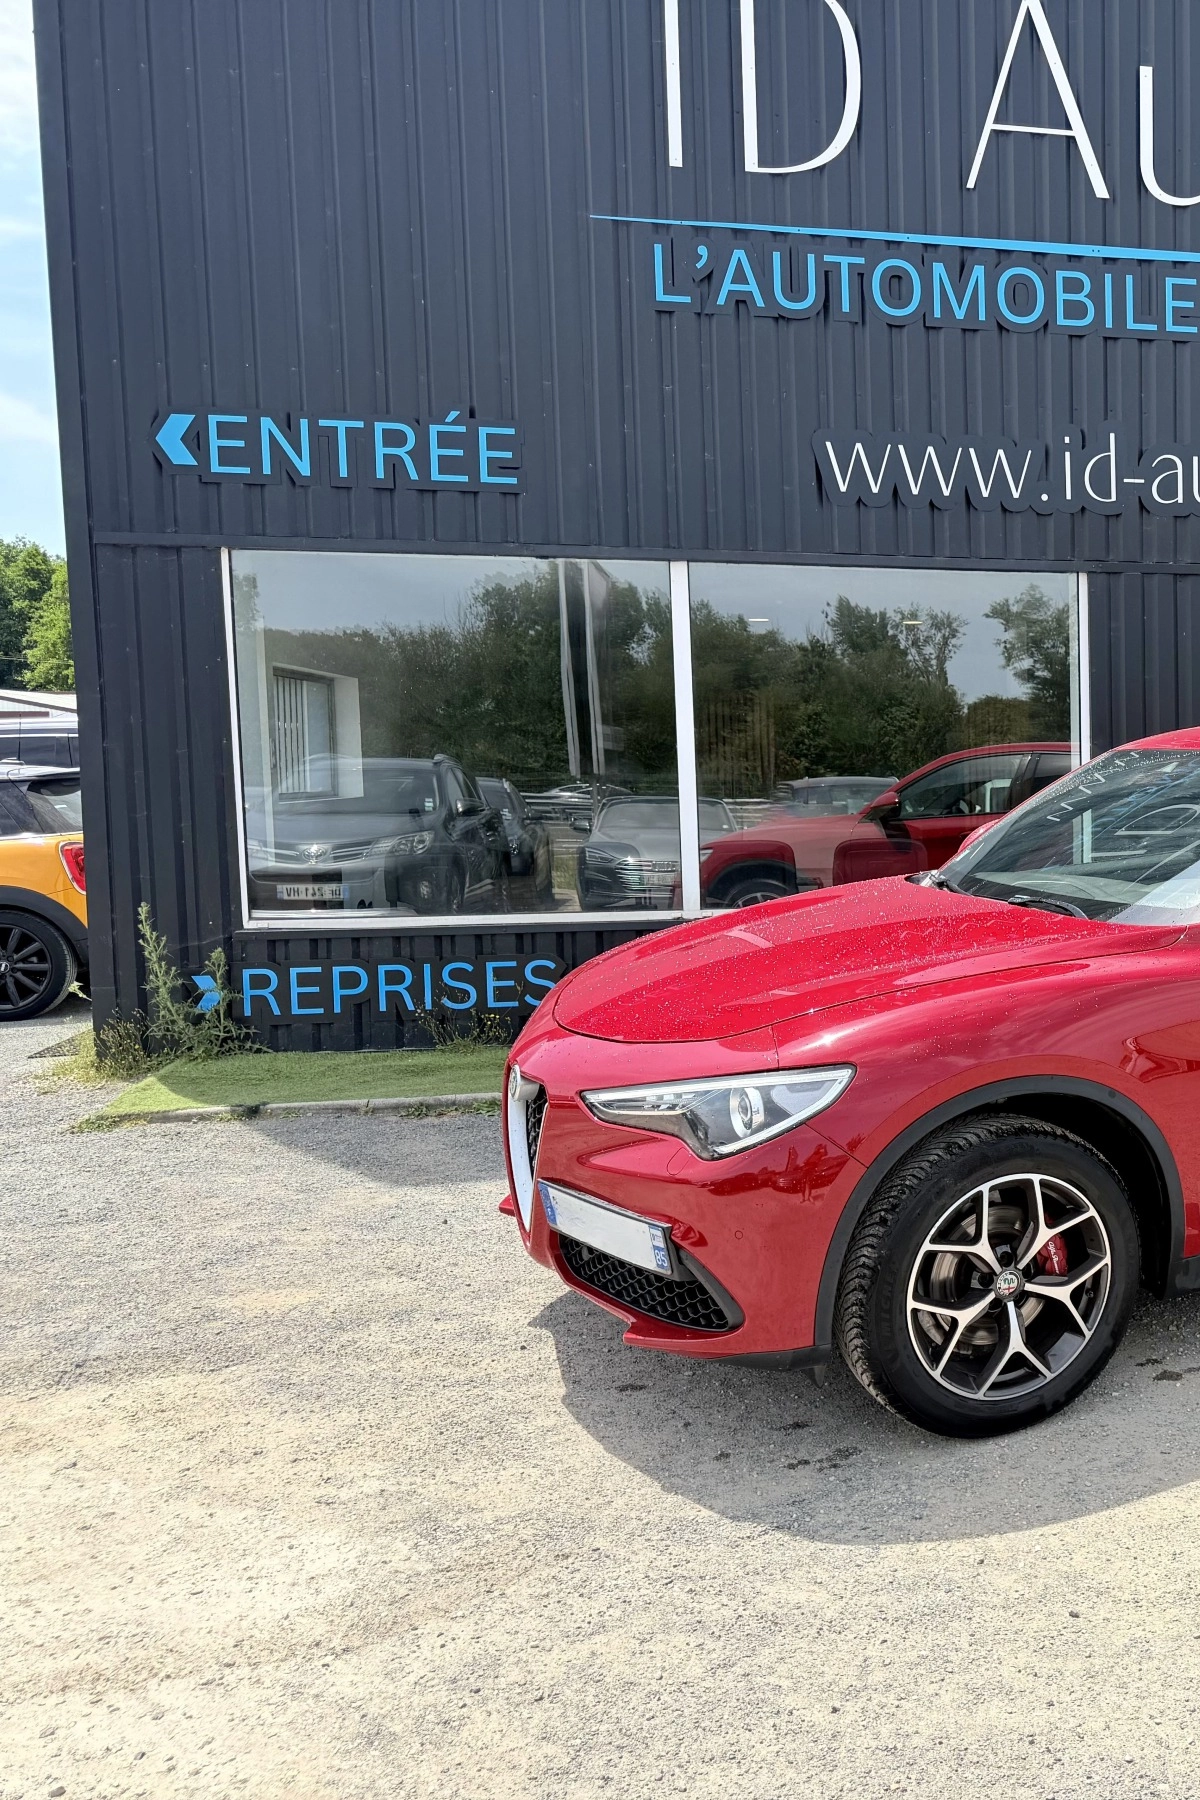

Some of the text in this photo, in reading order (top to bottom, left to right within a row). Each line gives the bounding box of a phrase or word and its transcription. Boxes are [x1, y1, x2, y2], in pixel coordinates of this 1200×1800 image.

[663, 0, 861, 175] ID
[653, 242, 1199, 334] L'AUTOMOBILE
[207, 410, 519, 486] ENTRÉE
[242, 959, 557, 1017] REPRISES
[654, 1249, 669, 1267] 85
